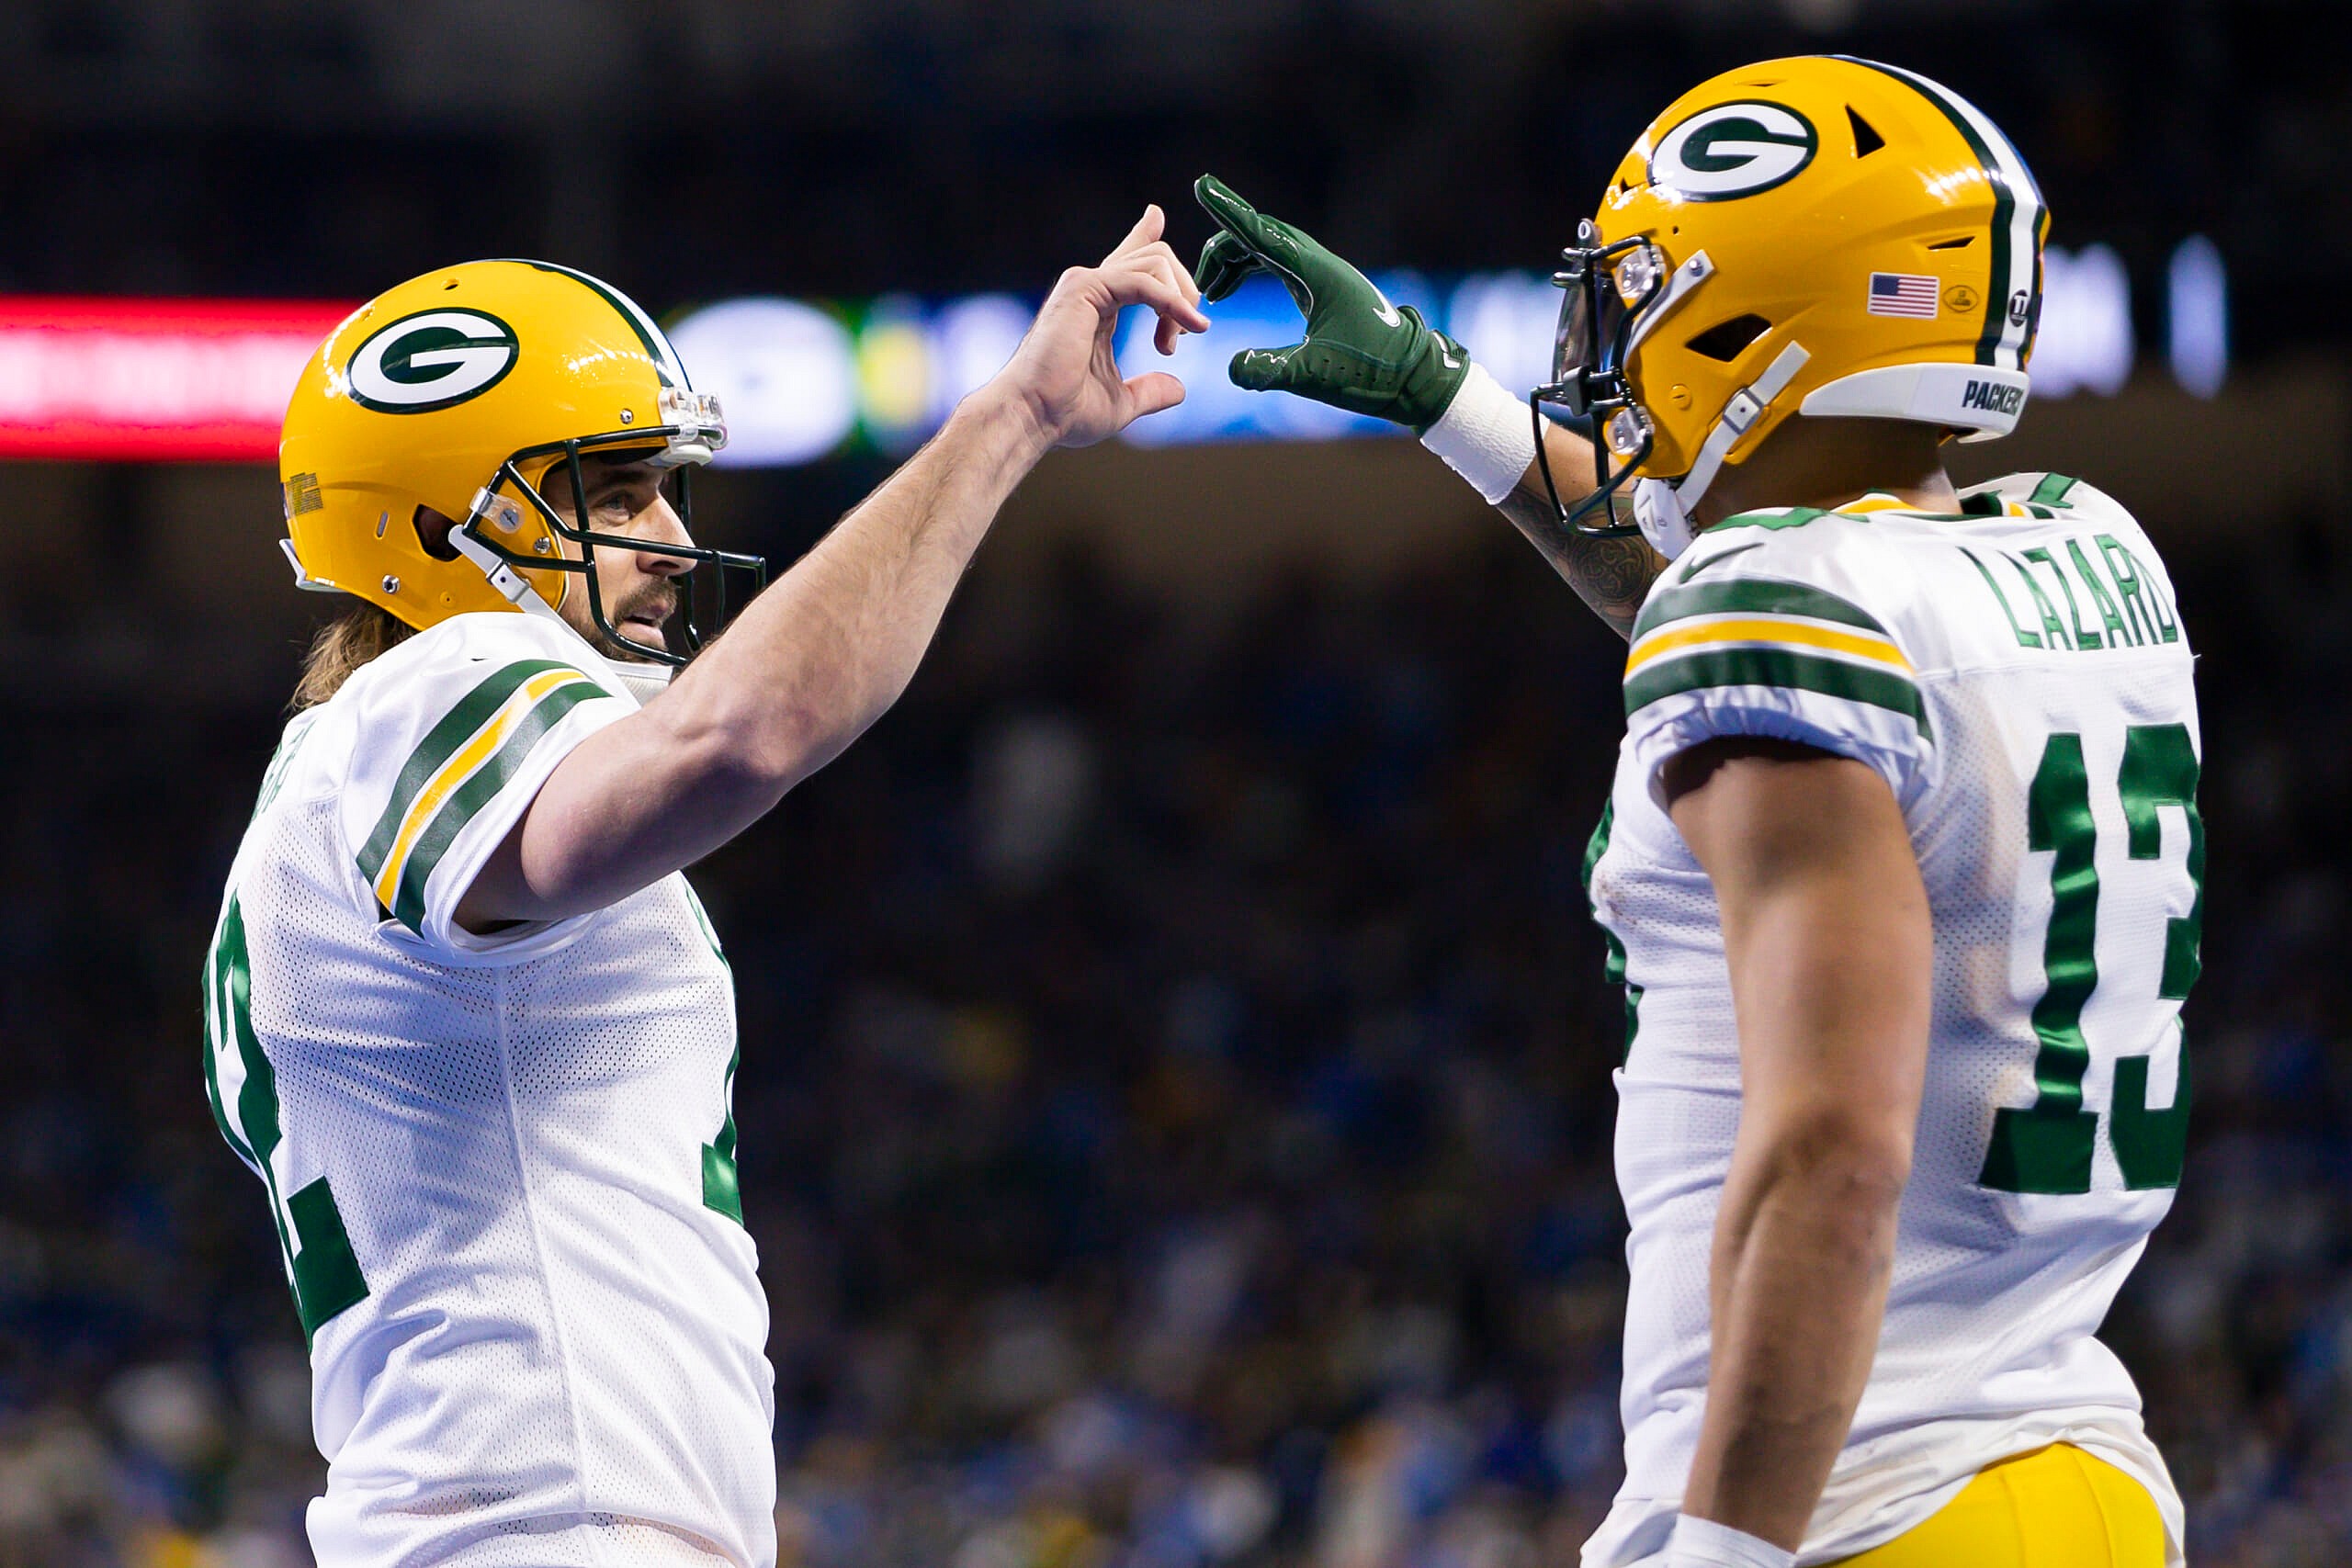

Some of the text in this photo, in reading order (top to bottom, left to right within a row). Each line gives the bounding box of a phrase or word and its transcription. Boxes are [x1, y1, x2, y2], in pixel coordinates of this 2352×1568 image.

[1651, 103, 1809, 193] G
[350, 311, 511, 404] G
[1956, 534, 2178, 651] LAZARD
[1978, 722, 2205, 1195] 13
